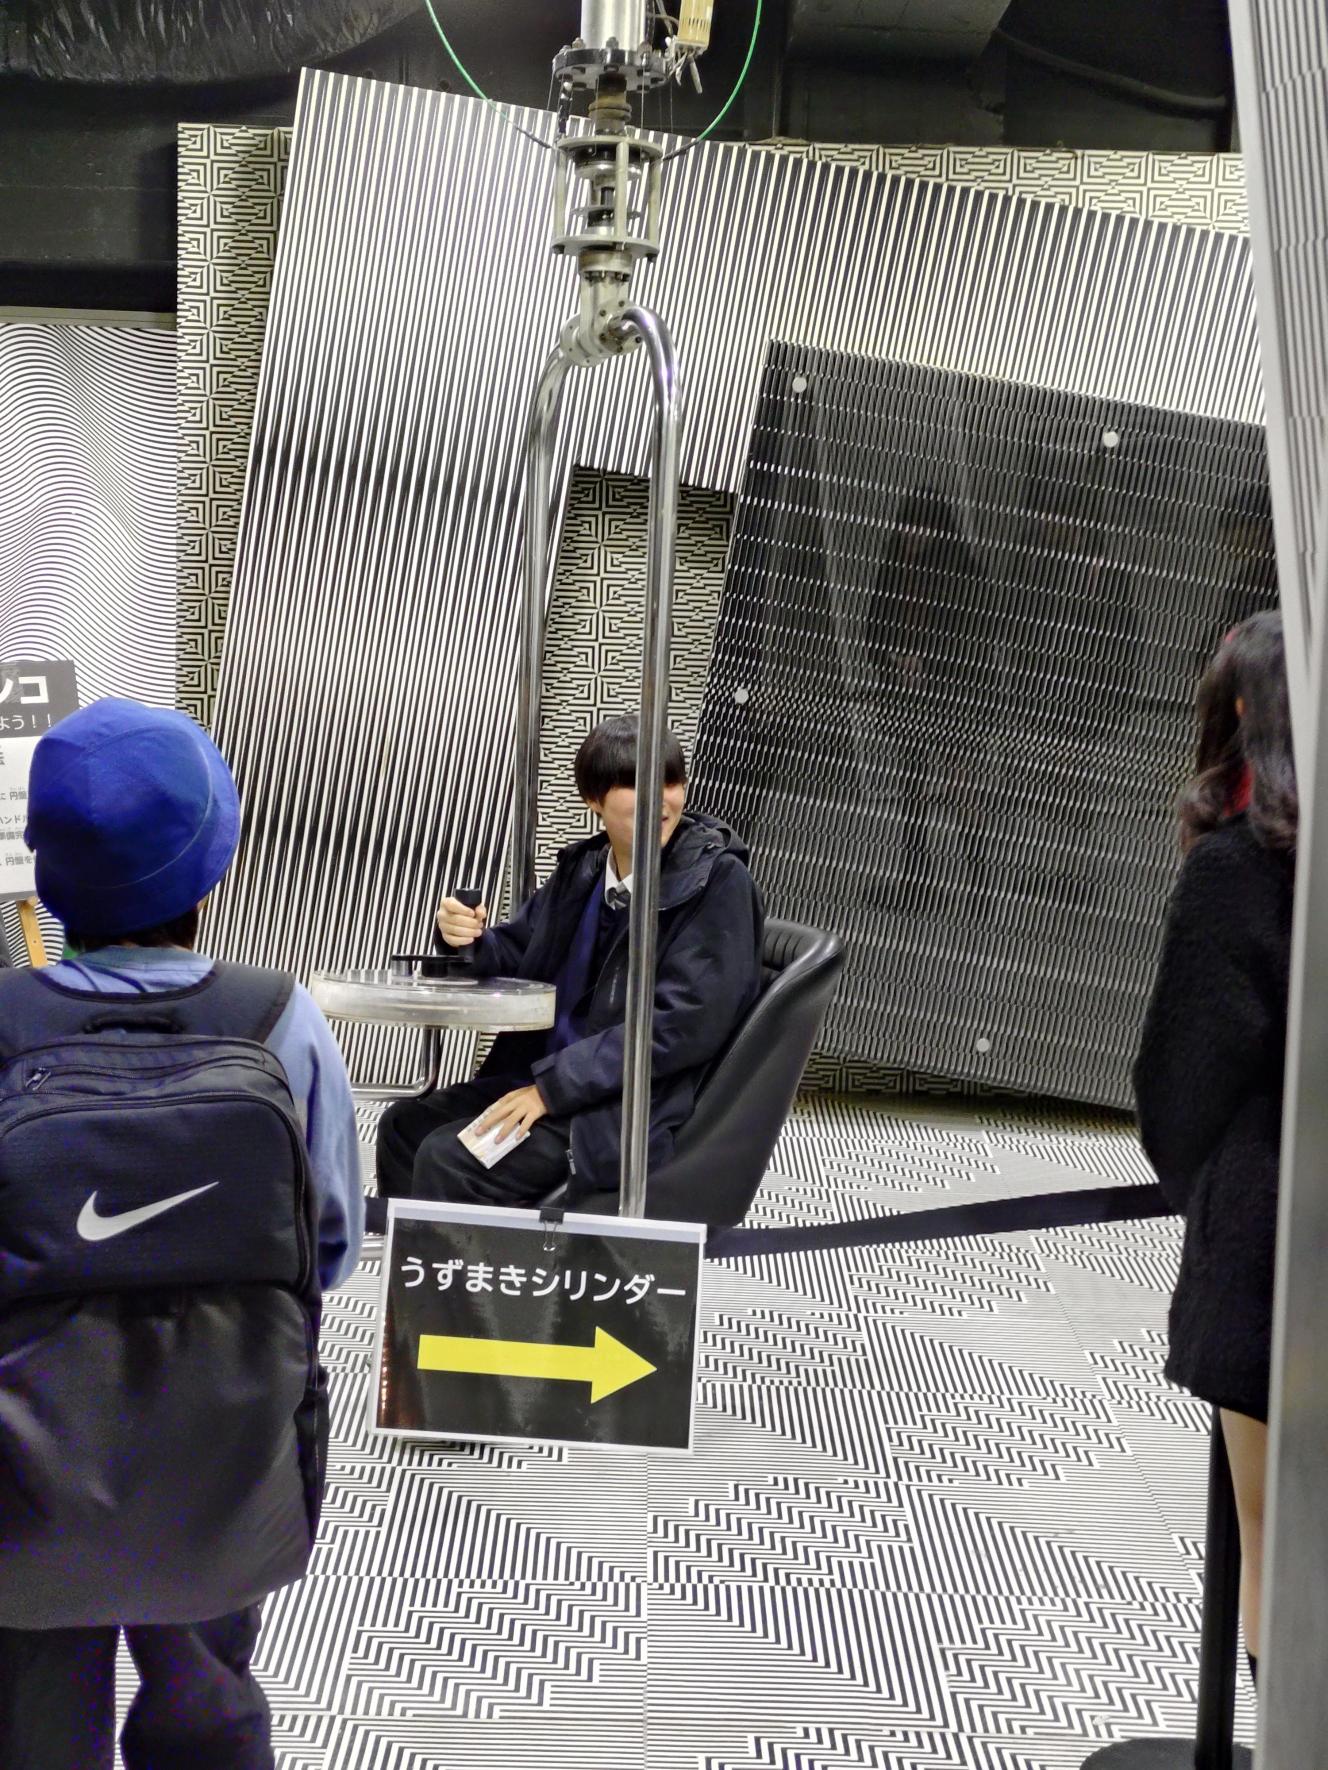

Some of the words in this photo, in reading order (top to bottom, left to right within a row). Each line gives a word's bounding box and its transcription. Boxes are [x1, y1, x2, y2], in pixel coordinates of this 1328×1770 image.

[401, 1256, 687, 1305] うずまきシリンダー
